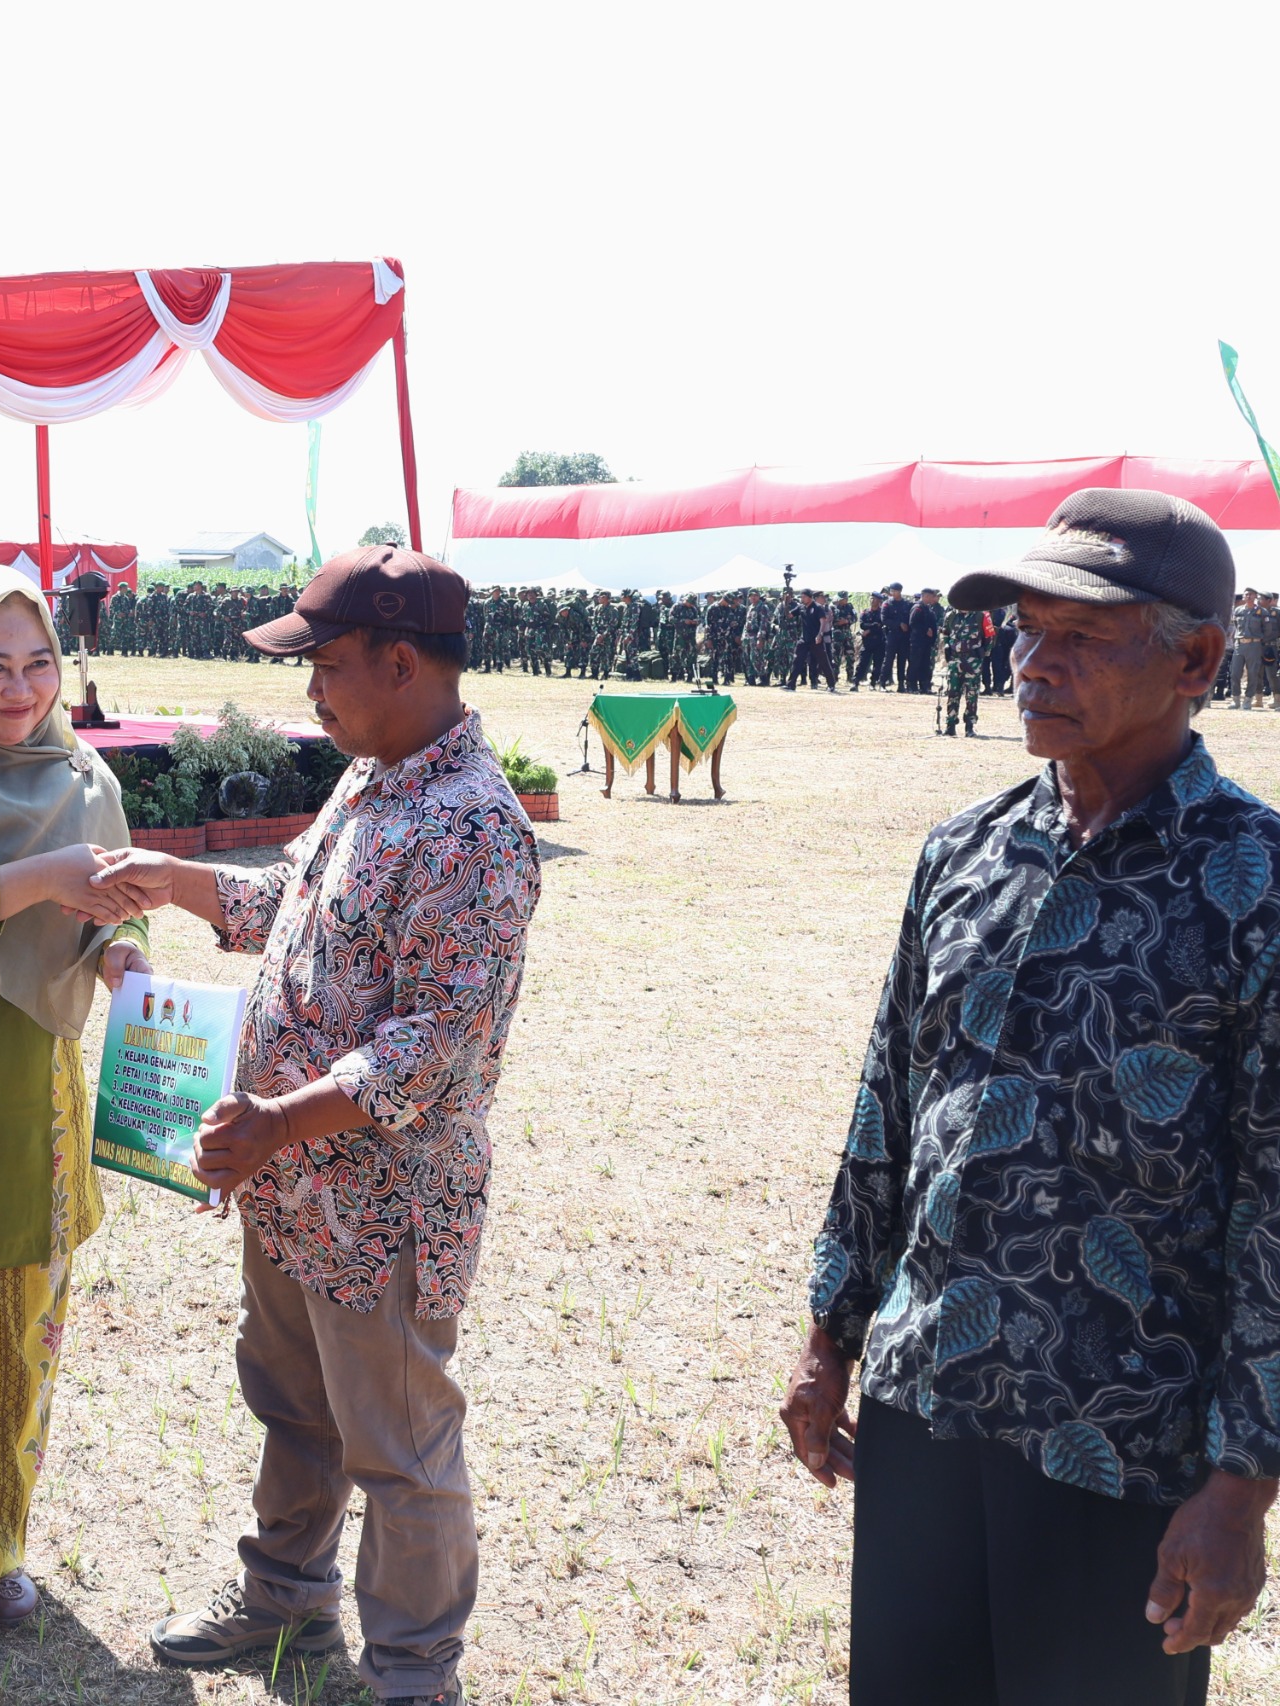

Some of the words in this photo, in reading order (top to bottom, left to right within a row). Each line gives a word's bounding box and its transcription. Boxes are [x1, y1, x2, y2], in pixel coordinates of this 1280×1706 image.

[123, 1023, 173, 1054] BANTUAN
[174, 1033, 208, 1061] BIBIT
[115, 1064, 121, 1075] 2.
[122, 1066, 141, 1080] PETAI
[141, 1070, 161, 1086] (1.500
[162, 1076, 177, 1091] BTG)
[125, 1050, 149, 1066] KELAPA
[150, 1055, 177, 1072] GENJAH
[177, 1062, 192, 1075] (750
[192, 1065, 209, 1080] BTG)
[110, 1096, 117, 1107] 4.
[119, 1098, 161, 1119] KELENGKENG
[162, 1109, 177, 1124] (200
[179, 1113, 195, 1131] BTG)
[113, 1080, 119, 1091] 3.
[120, 1083, 142, 1097] JERUK
[143, 1087, 168, 1104] KEPROK
[169, 1092, 184, 1108] (300
[185, 1098, 202, 1115] BTG)
[109, 1111, 115, 1122] 5.
[116, 1114, 146, 1131] ALPUKAT
[147, 1122, 161, 1137] (250
[162, 1126, 178, 1143] BTG)
[94, 1138, 116, 1160] DINAS
[131, 1149, 160, 1176] PANGAN
[161, 1158, 167, 1178] &
